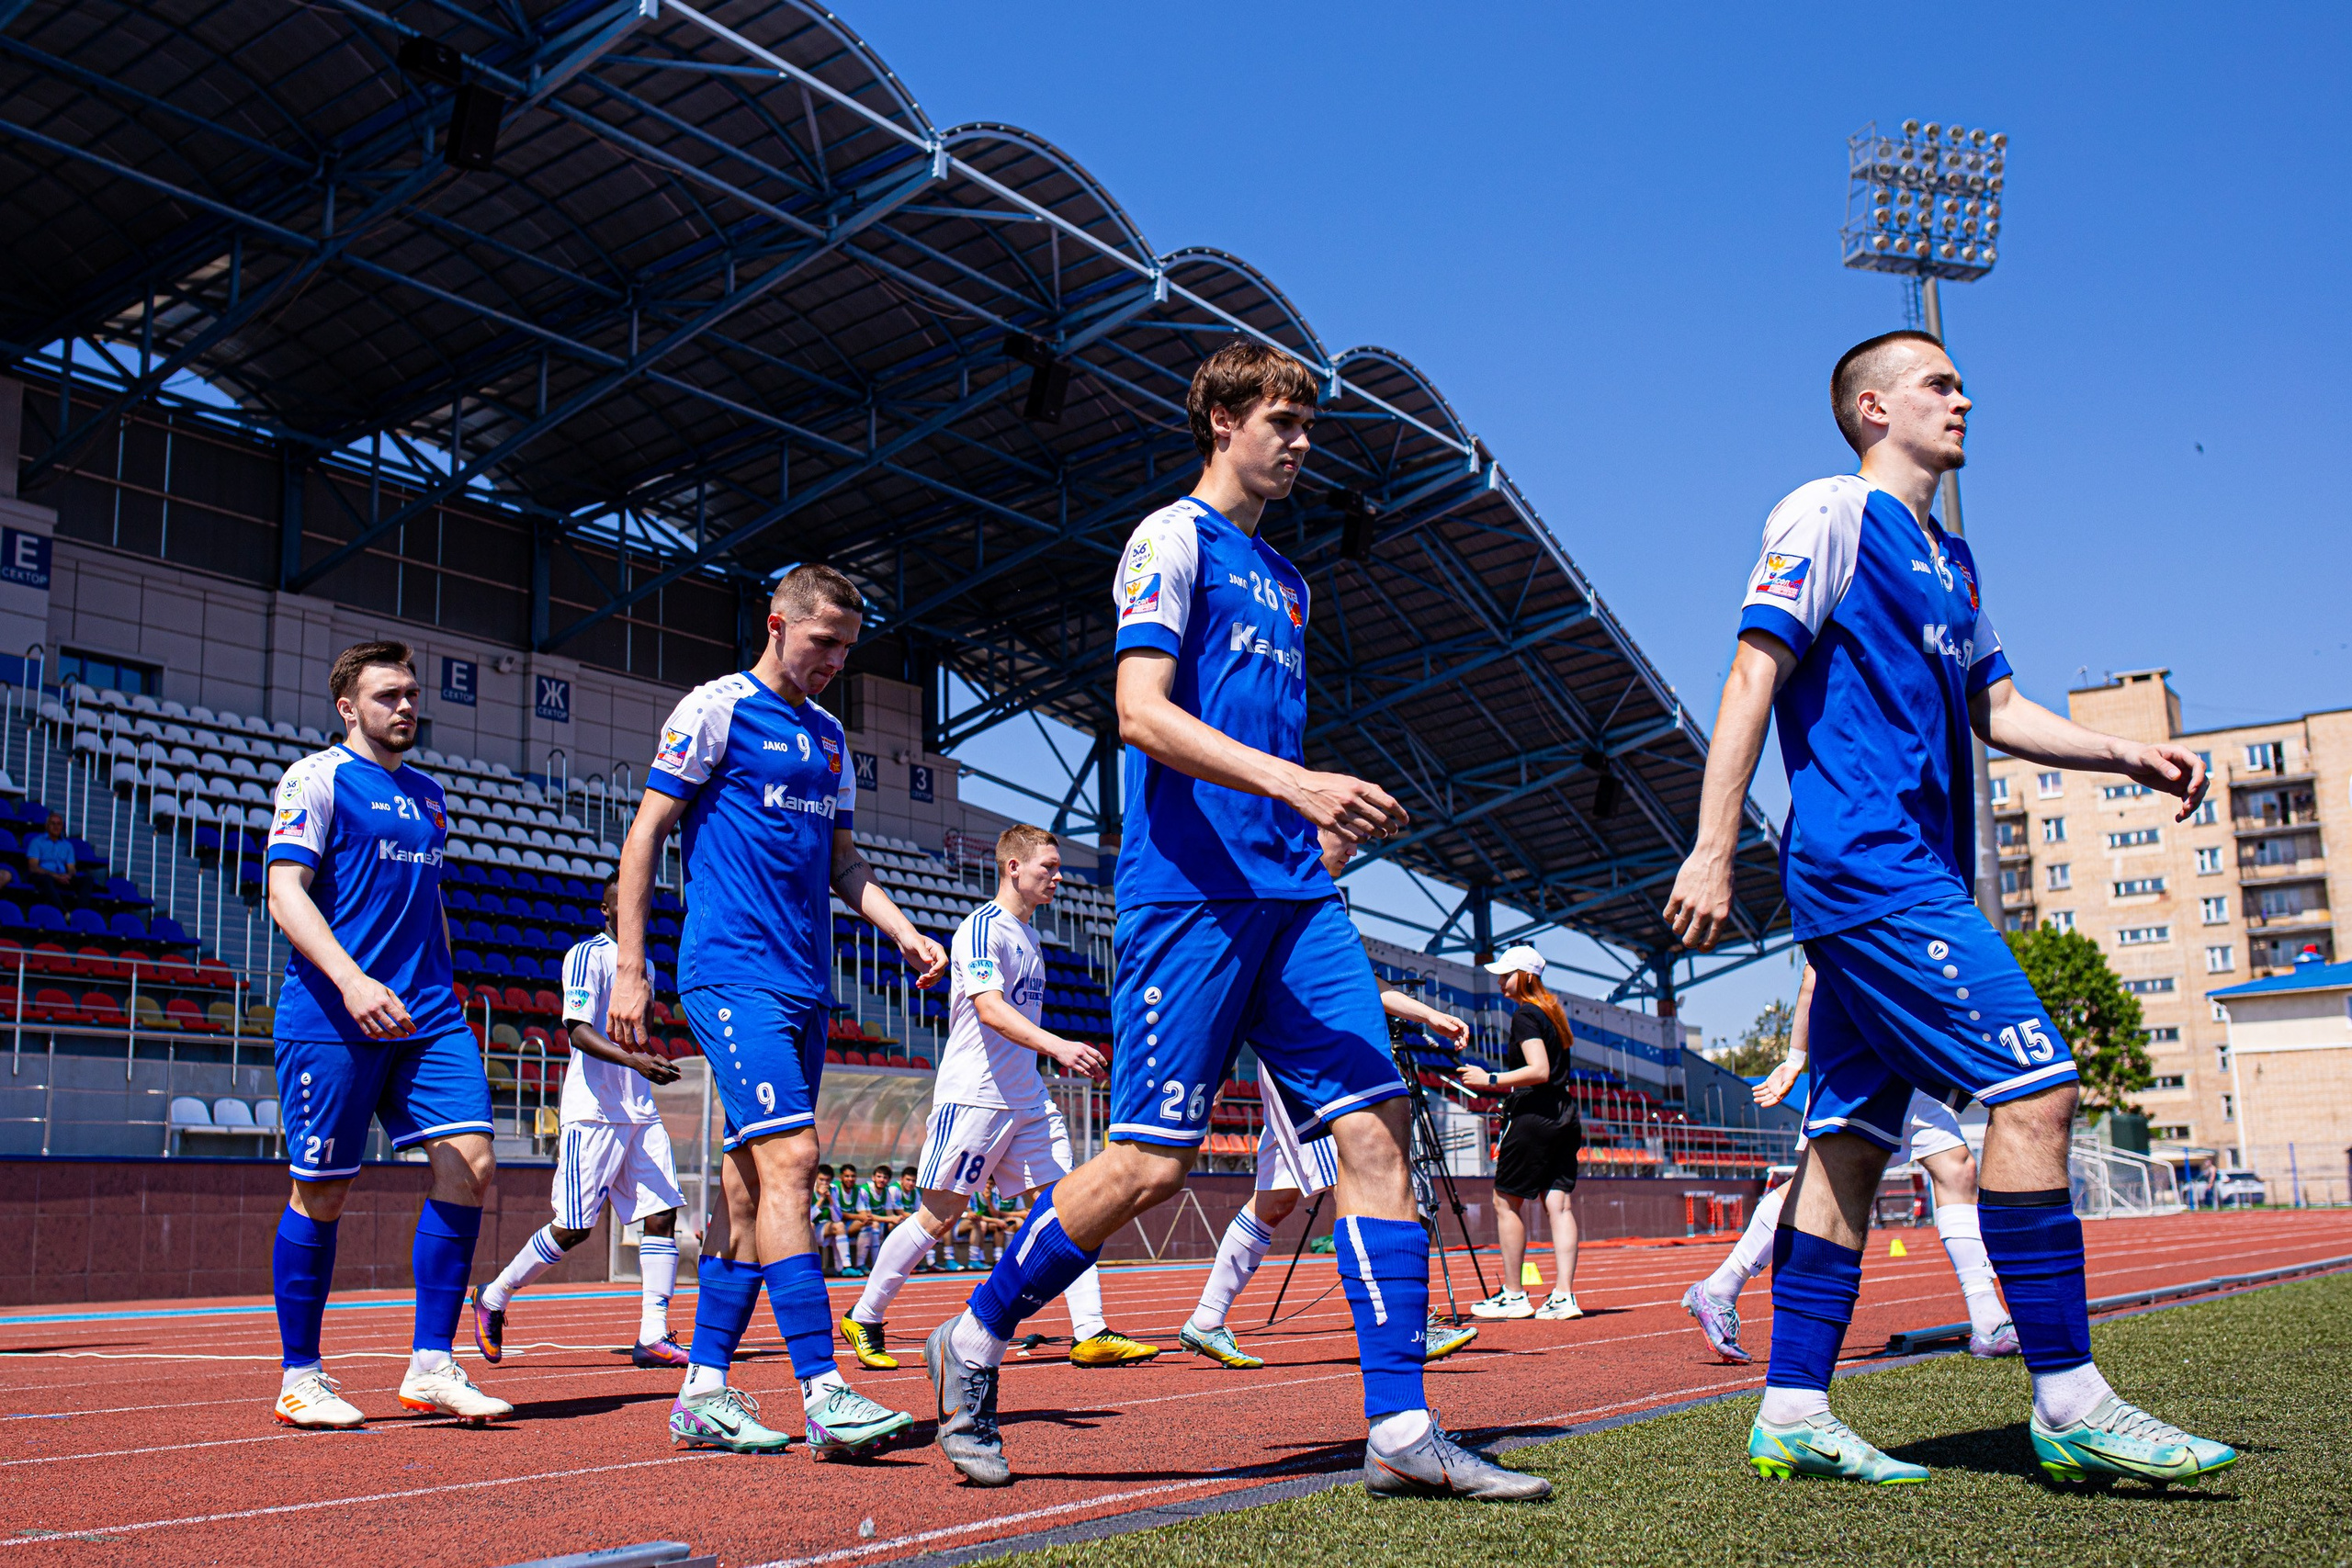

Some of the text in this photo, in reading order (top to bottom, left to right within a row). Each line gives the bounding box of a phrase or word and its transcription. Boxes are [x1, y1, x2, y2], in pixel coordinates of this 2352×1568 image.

[2, 565, 49, 585] СЕКТОР
[1250, 570, 1279, 612] 26
[541, 678, 566, 709] Ж
[763, 739, 788, 752] JAKO
[796, 733, 811, 762] 9
[855, 753, 874, 780] Ж
[371, 801, 391, 811] JAKO
[393, 795, 422, 821] 21
[1998, 1017, 2055, 1068] 15
[755, 1081, 776, 1115] 9
[1159, 1079, 1207, 1122] 26
[303, 1135, 336, 1166] 21
[955, 1149, 986, 1185] 18
